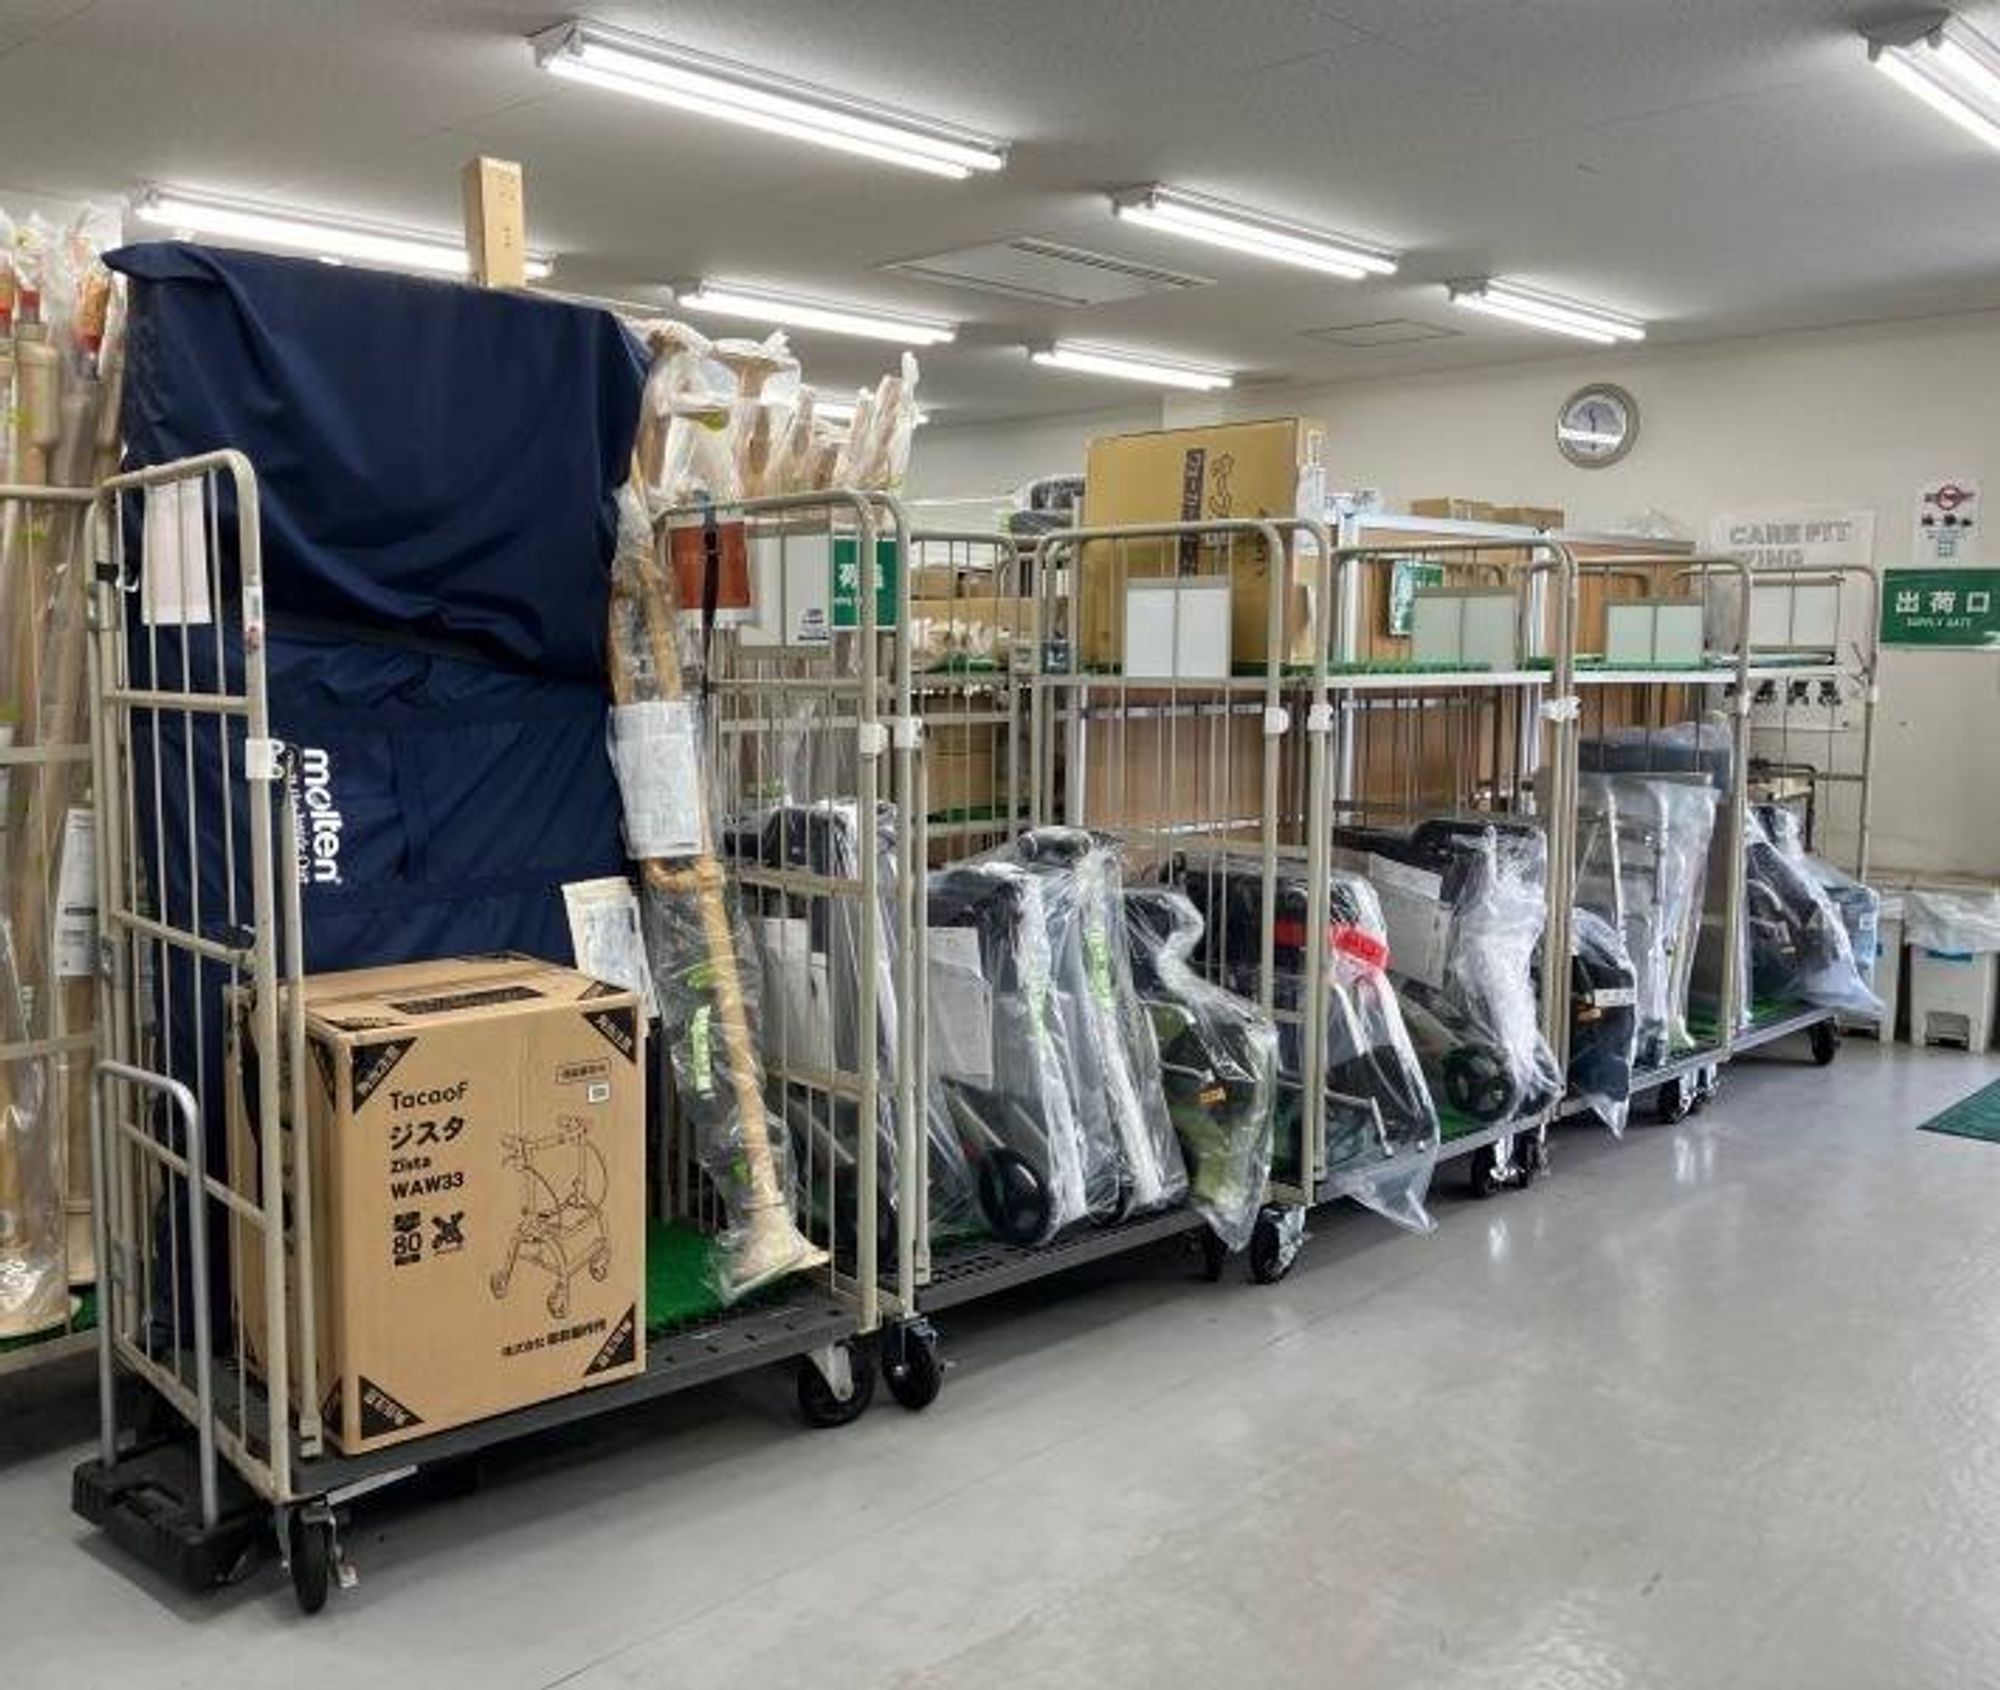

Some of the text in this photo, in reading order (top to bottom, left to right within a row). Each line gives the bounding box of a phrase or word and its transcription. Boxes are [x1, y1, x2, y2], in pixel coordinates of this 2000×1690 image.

[1896, 590, 1990, 614] 出荷口
[304, 749, 343, 883] molten
[390, 1115, 465, 1150] ジスタ
[391, 1171, 465, 1199] WAW33
[393, 1231, 422, 1255] 80
